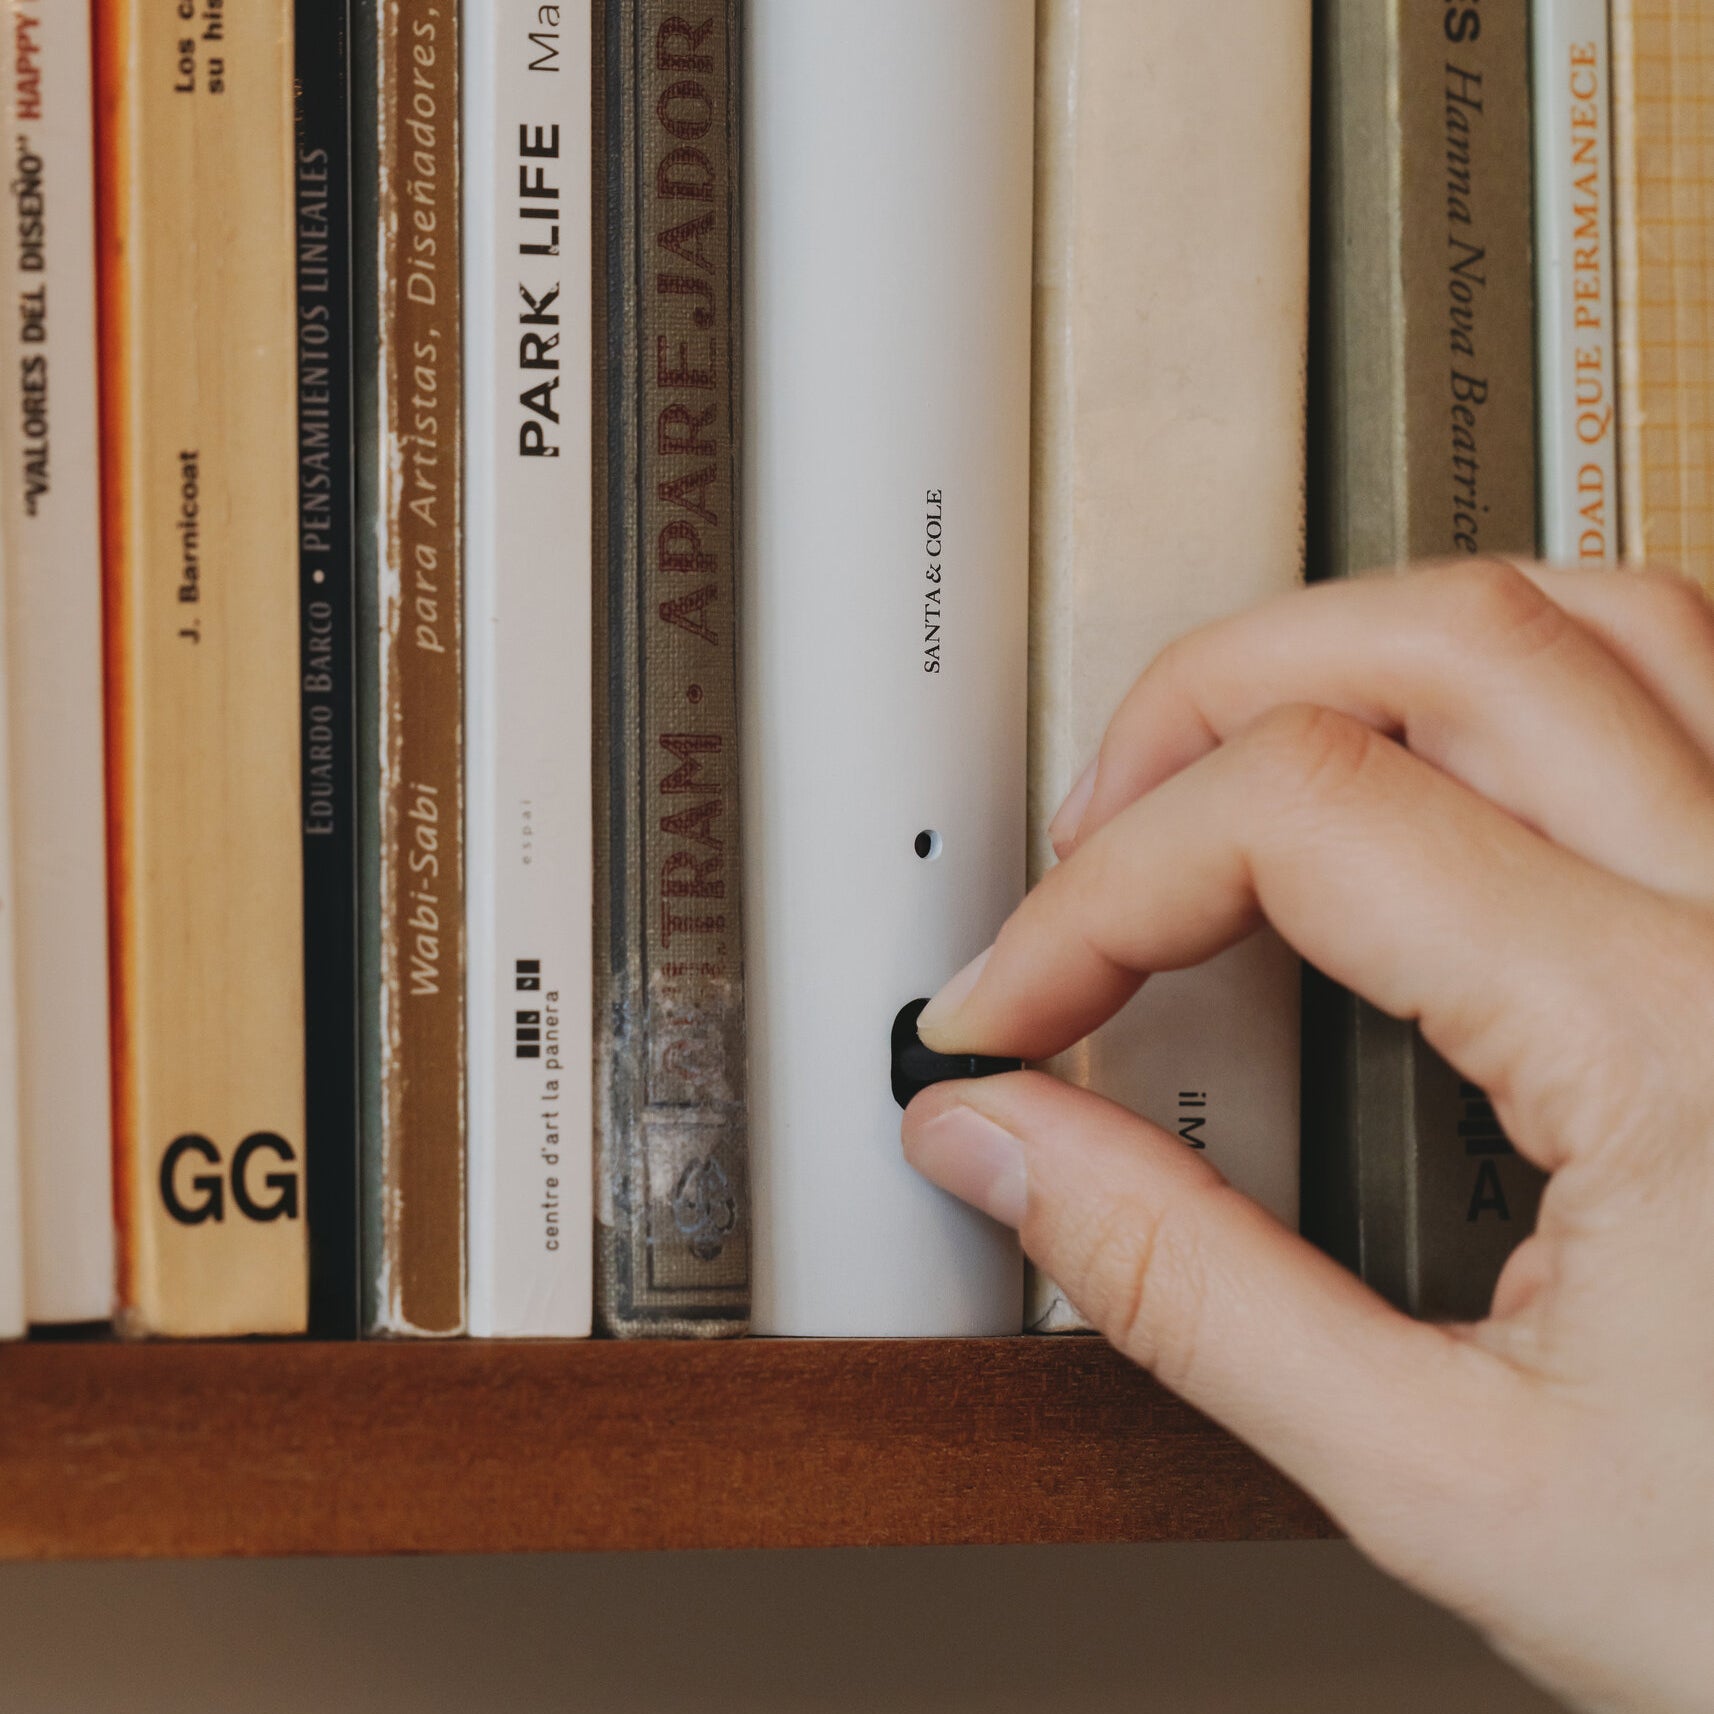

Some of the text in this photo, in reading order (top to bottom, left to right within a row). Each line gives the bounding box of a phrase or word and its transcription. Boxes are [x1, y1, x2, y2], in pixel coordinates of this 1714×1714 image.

[15, 12, 42, 120] HAPPY
[174, 0, 195, 93] Los c
[208, 58, 224, 94] su
[528, 5, 560, 72] Ma
[1443, 0, 1490, 554] S Hanna Nova Beatrice
[1570, 42, 1601, 330] PERMANECE
[20, 286, 46, 343] DEL
[519, 123, 560, 457] PARK LIFE
[656, 16, 718, 646] APAREJADOR
[1575, 346, 1613, 445] QUE
[178, 450, 200, 644] J. Barnicoat
[301, 148, 333, 835] EDUARDO BARCO PENSAMIENTOS LINEALES
[406, 8, 445, 995] Wabi-Sabi para Artistas, Diseñadores,
[923, 488, 942, 674] SANTA & COLE
[159, 1130, 299, 1226] GG
[540, 989, 563, 1252] centre d'art la panera
